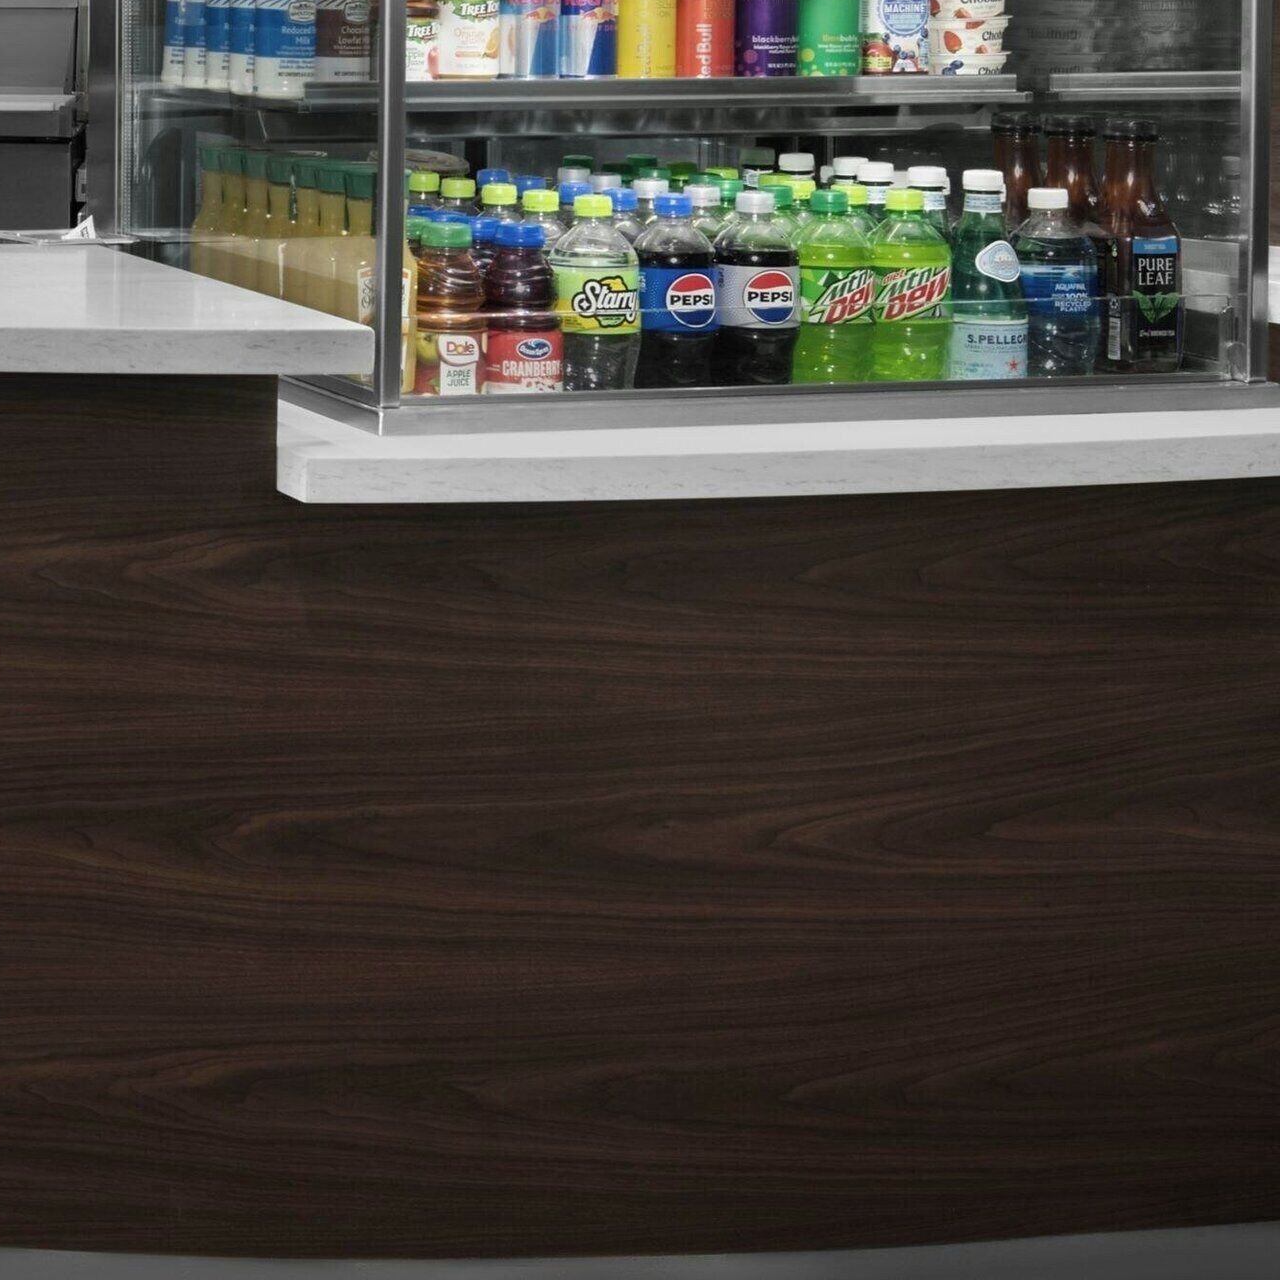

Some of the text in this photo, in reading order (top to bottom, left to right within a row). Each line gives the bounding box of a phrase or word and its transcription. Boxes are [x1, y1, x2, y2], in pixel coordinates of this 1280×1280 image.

[884, 3, 925, 13] MACHINE
[295, 36, 311, 45] Milk
[696, 23, 712, 53] Bull
[1138, 258, 1174, 272] PURE
[1138, 272, 1173, 286] LEAF
[573, 281, 637, 322] Starry
[670, 293, 713, 307] PEPSI
[747, 291, 793, 303] PEPSI
[446, 341, 475, 353] Dole
[446, 369, 471, 378] APPLE
[447, 378, 470, 387] JUICE
